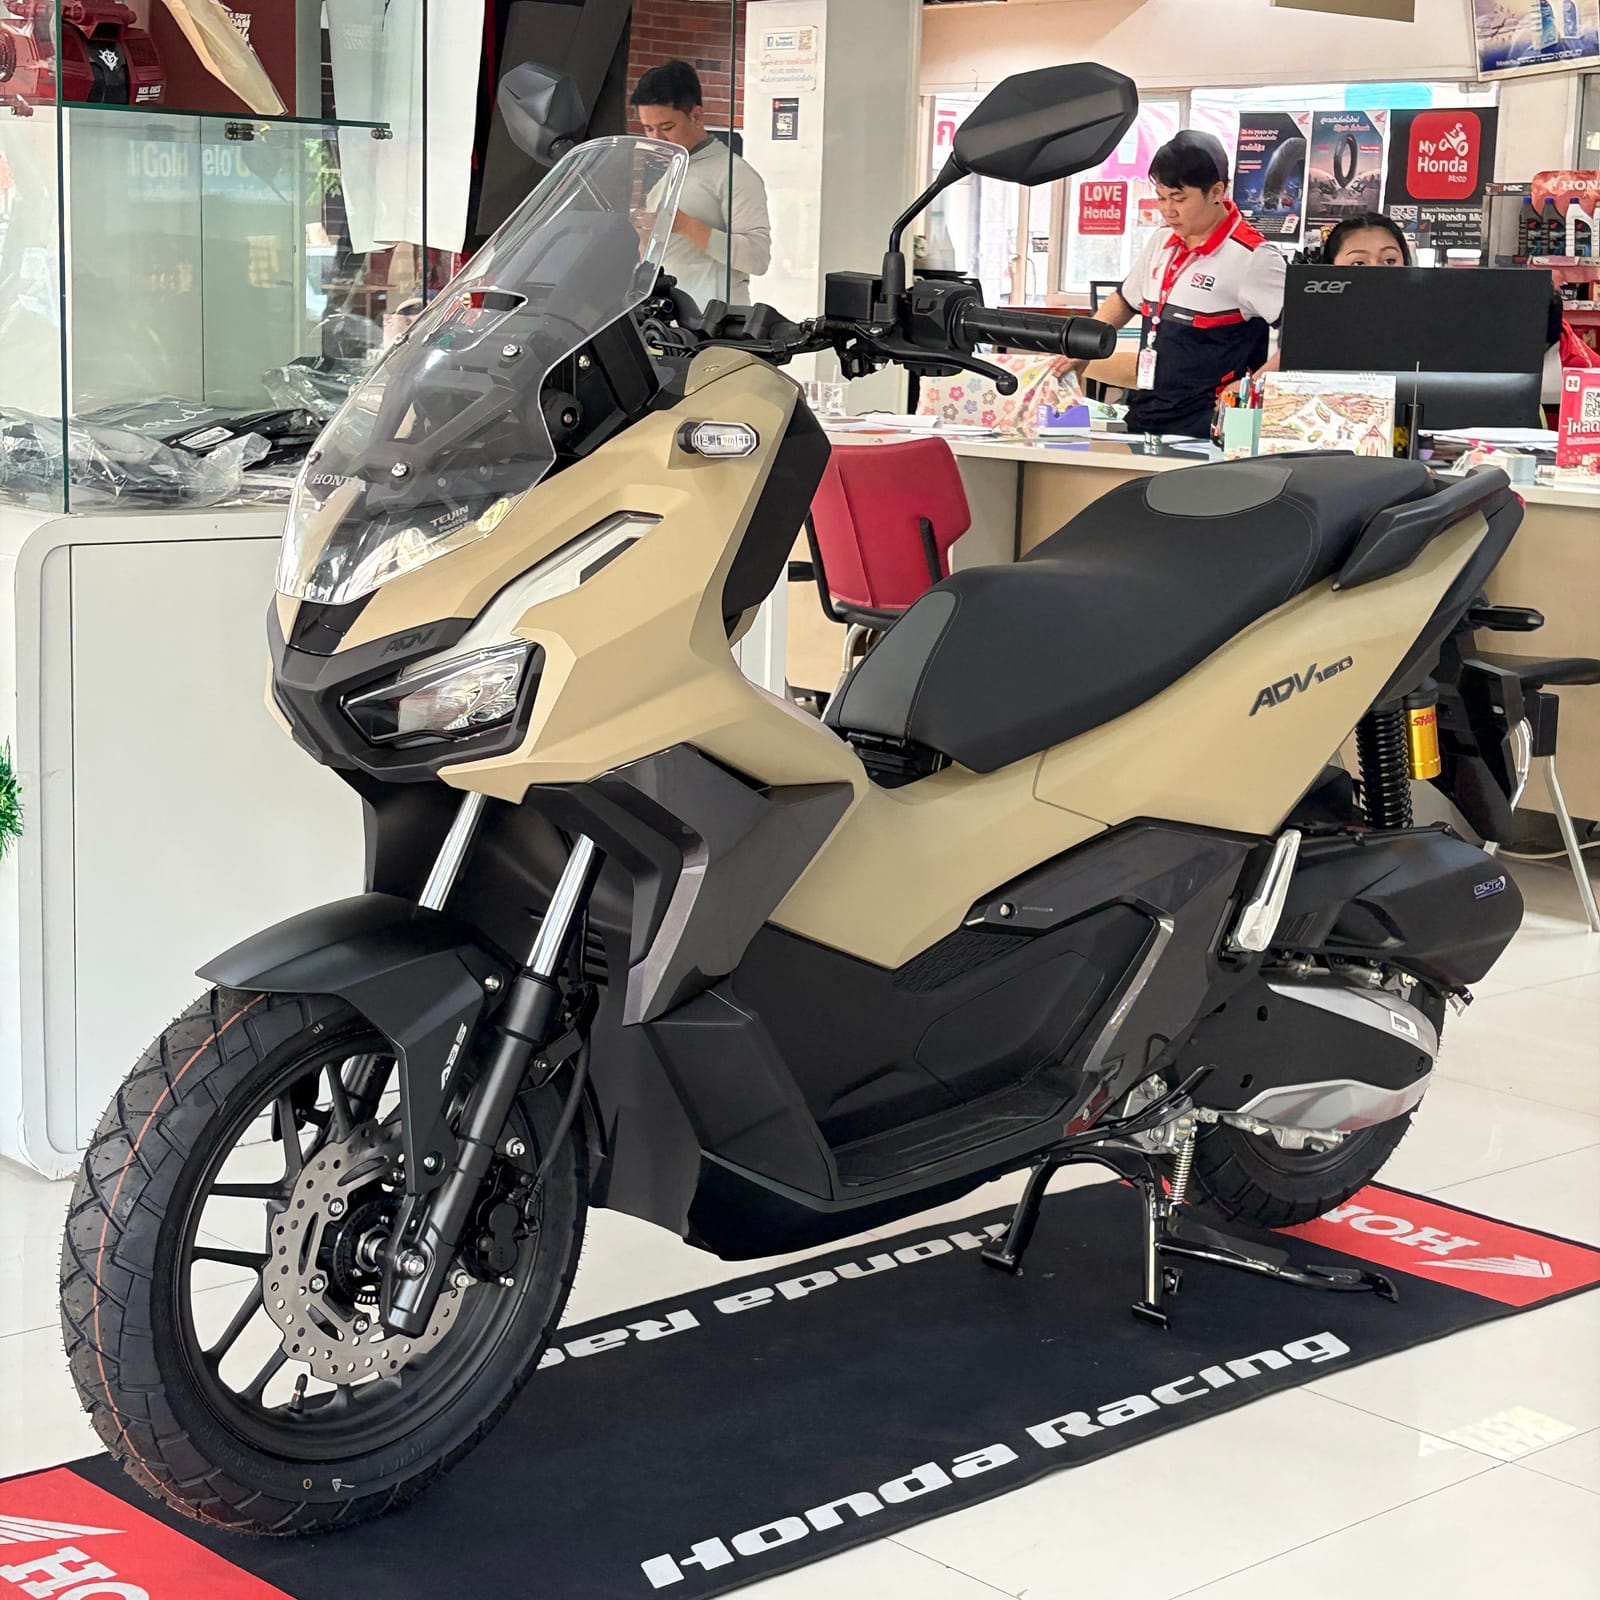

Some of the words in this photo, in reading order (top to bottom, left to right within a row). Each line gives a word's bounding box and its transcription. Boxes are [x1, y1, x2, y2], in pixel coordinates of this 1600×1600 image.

[1418, 140, 1436, 156] My
[1417, 156, 1468, 173] Honda
[1084, 185, 1123, 202] LOVE
[1083, 204, 1121, 220] Honda
[1303, 280, 1352, 294] acer
[714, 1224, 1011, 1314] Honda
[641, 1444, 1019, 1589] Honda
[1025, 1331, 1351, 1449] Racing
